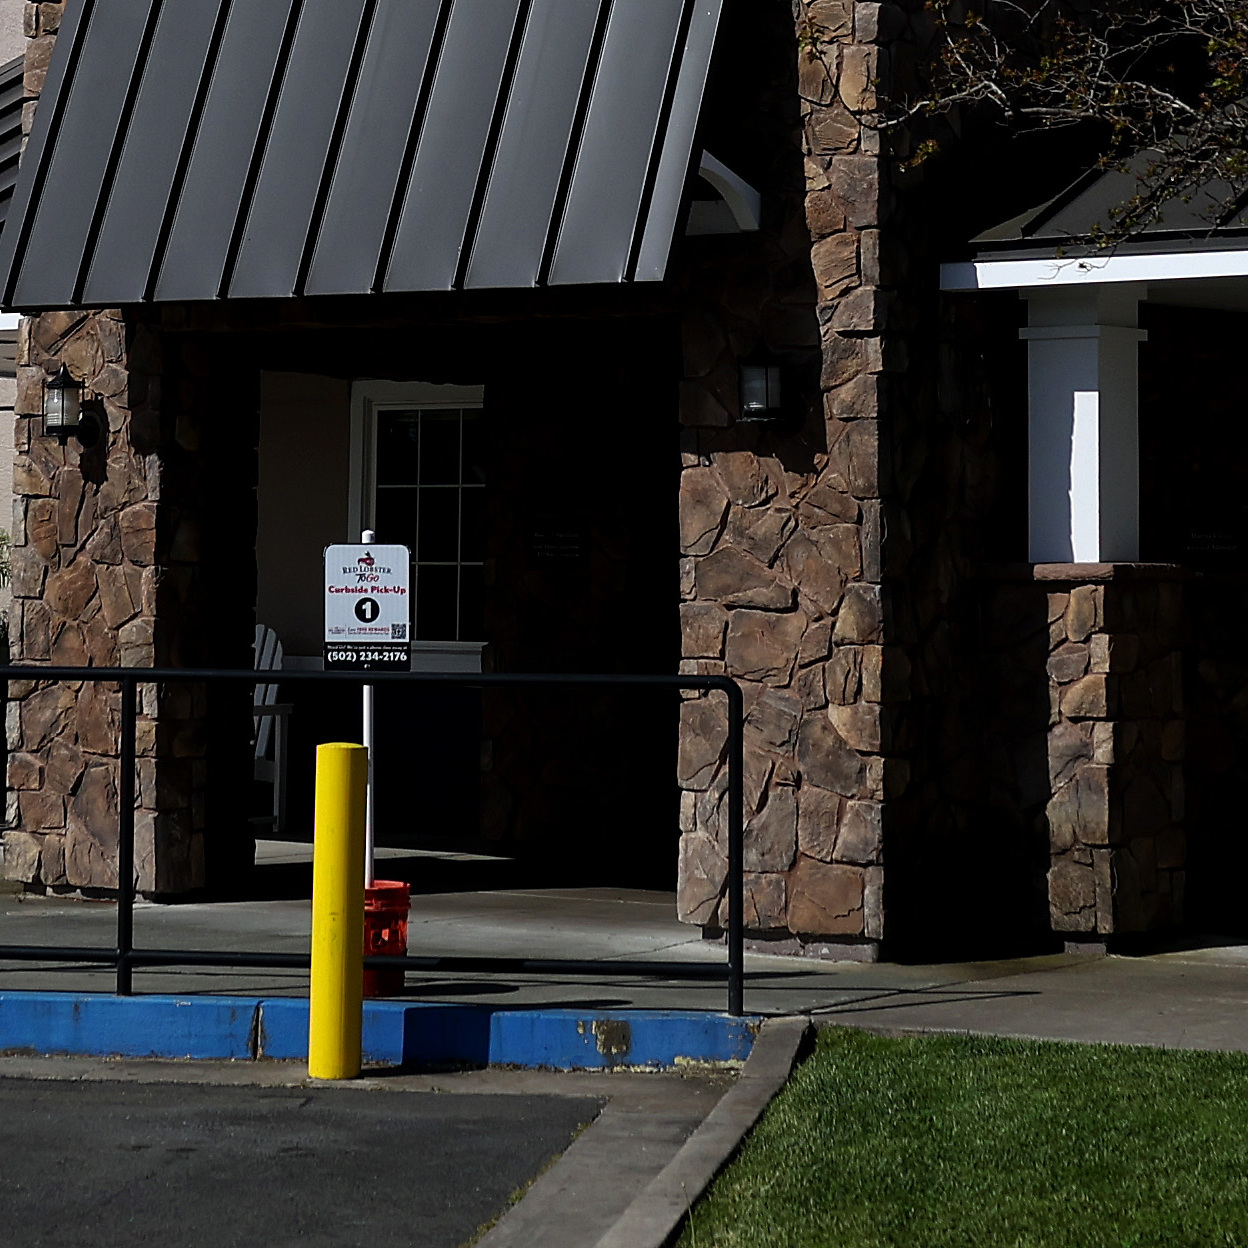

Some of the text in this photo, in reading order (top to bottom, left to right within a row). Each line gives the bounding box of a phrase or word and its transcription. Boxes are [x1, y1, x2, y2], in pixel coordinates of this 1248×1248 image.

[342, 565, 392, 575] RED LOBSTER
[328, 585, 407, 595] Curbside Pick-Up
[362, 601, 372, 619] 1
[327, 651, 408, 662] (502) 234-2176
